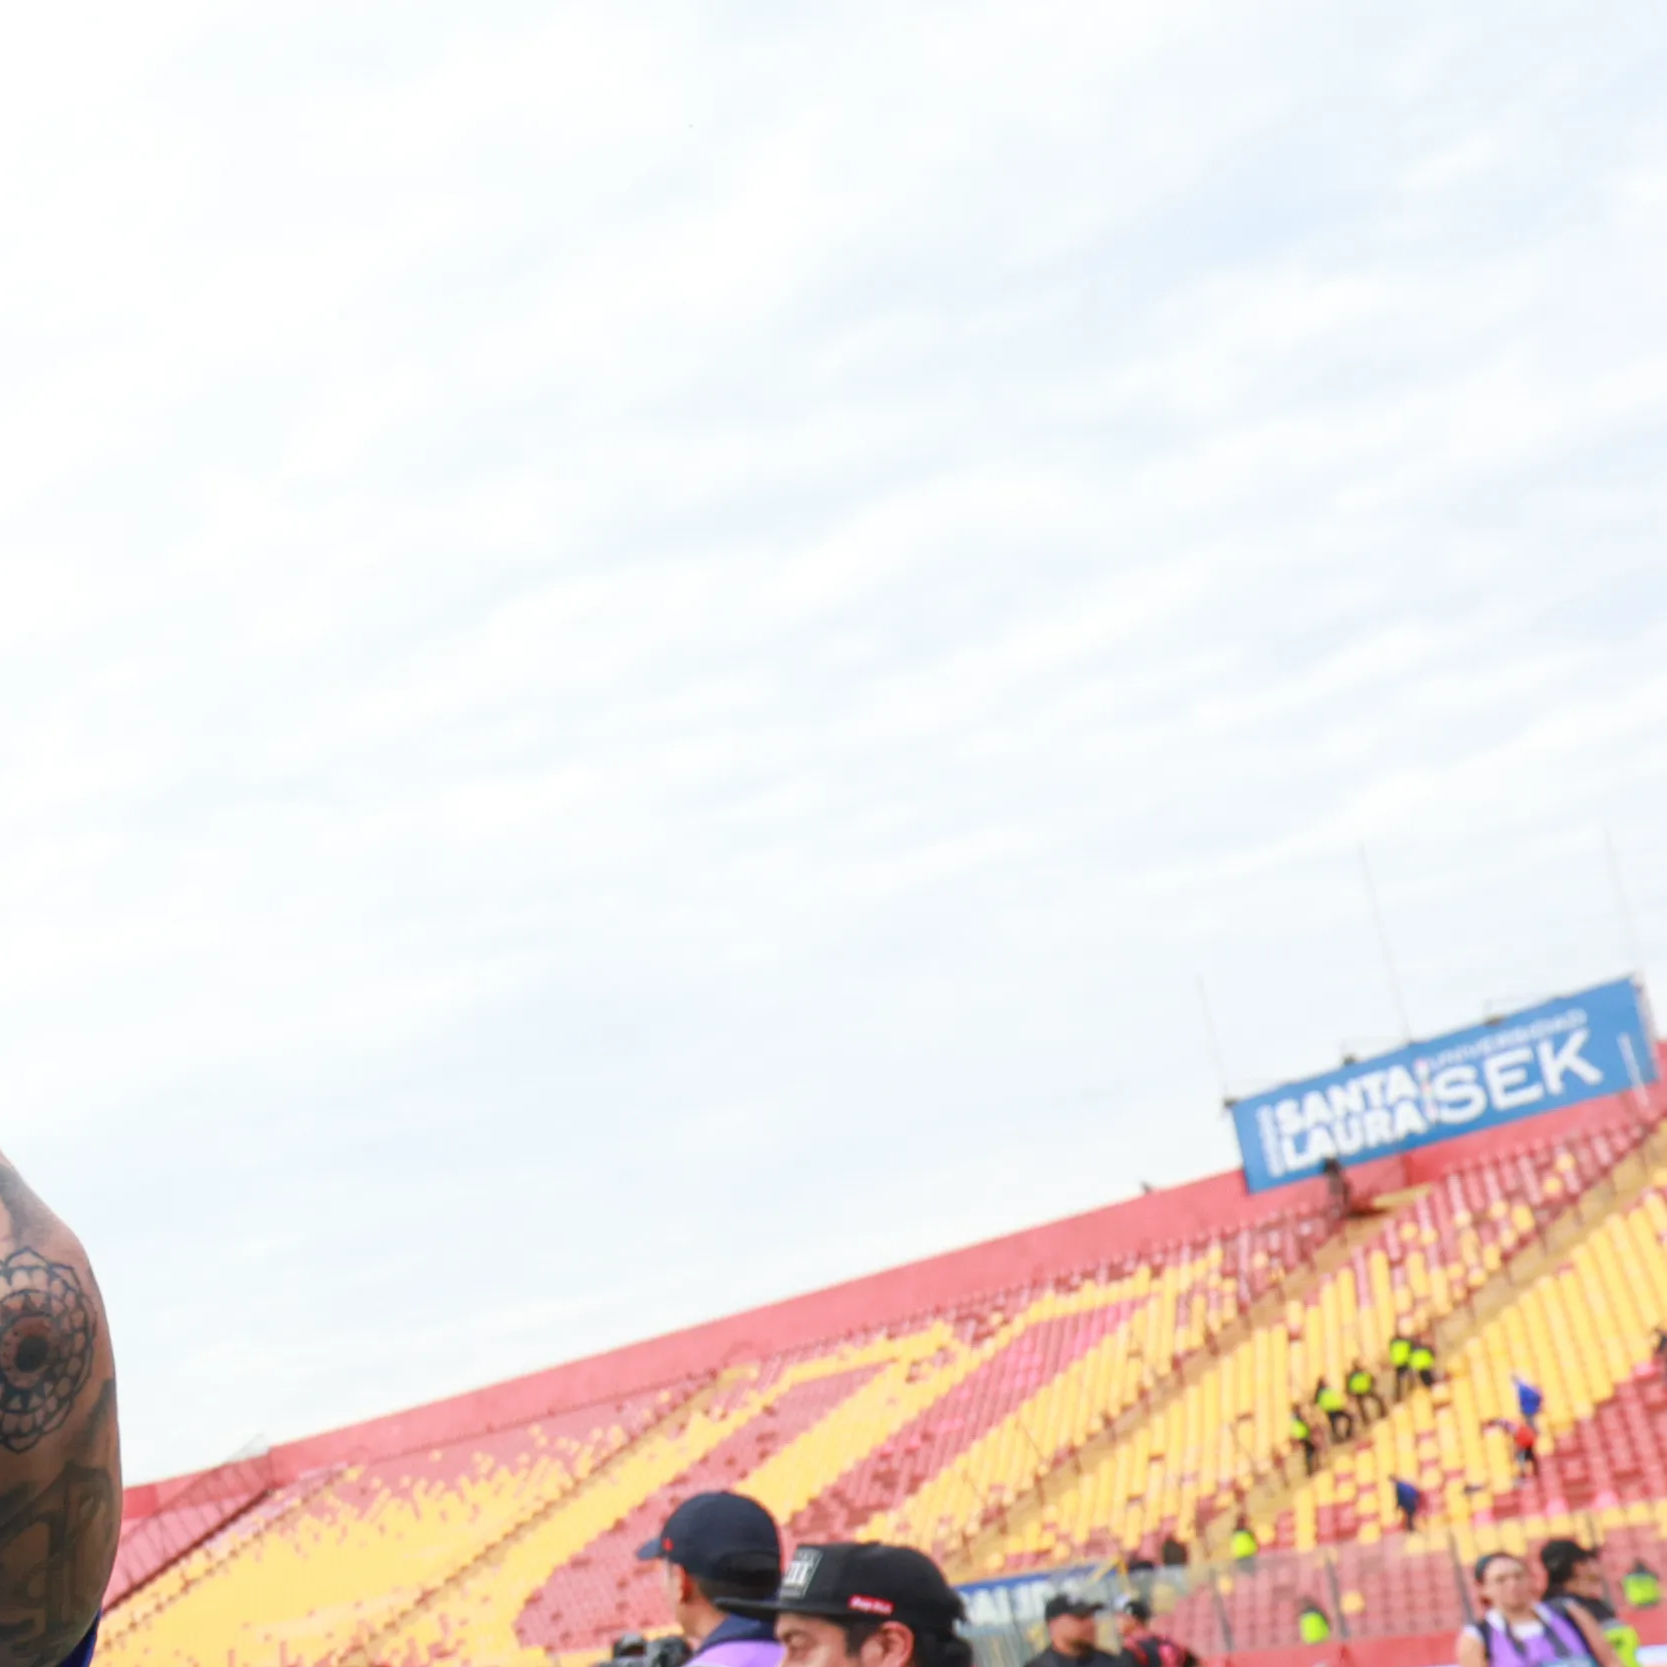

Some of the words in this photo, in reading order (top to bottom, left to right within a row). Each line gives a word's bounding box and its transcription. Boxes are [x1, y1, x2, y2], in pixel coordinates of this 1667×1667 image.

[1276, 1064, 1417, 1134] SANTA
[1432, 1028, 1604, 1124] SEK
[1283, 1101, 1427, 1171] LAURA
